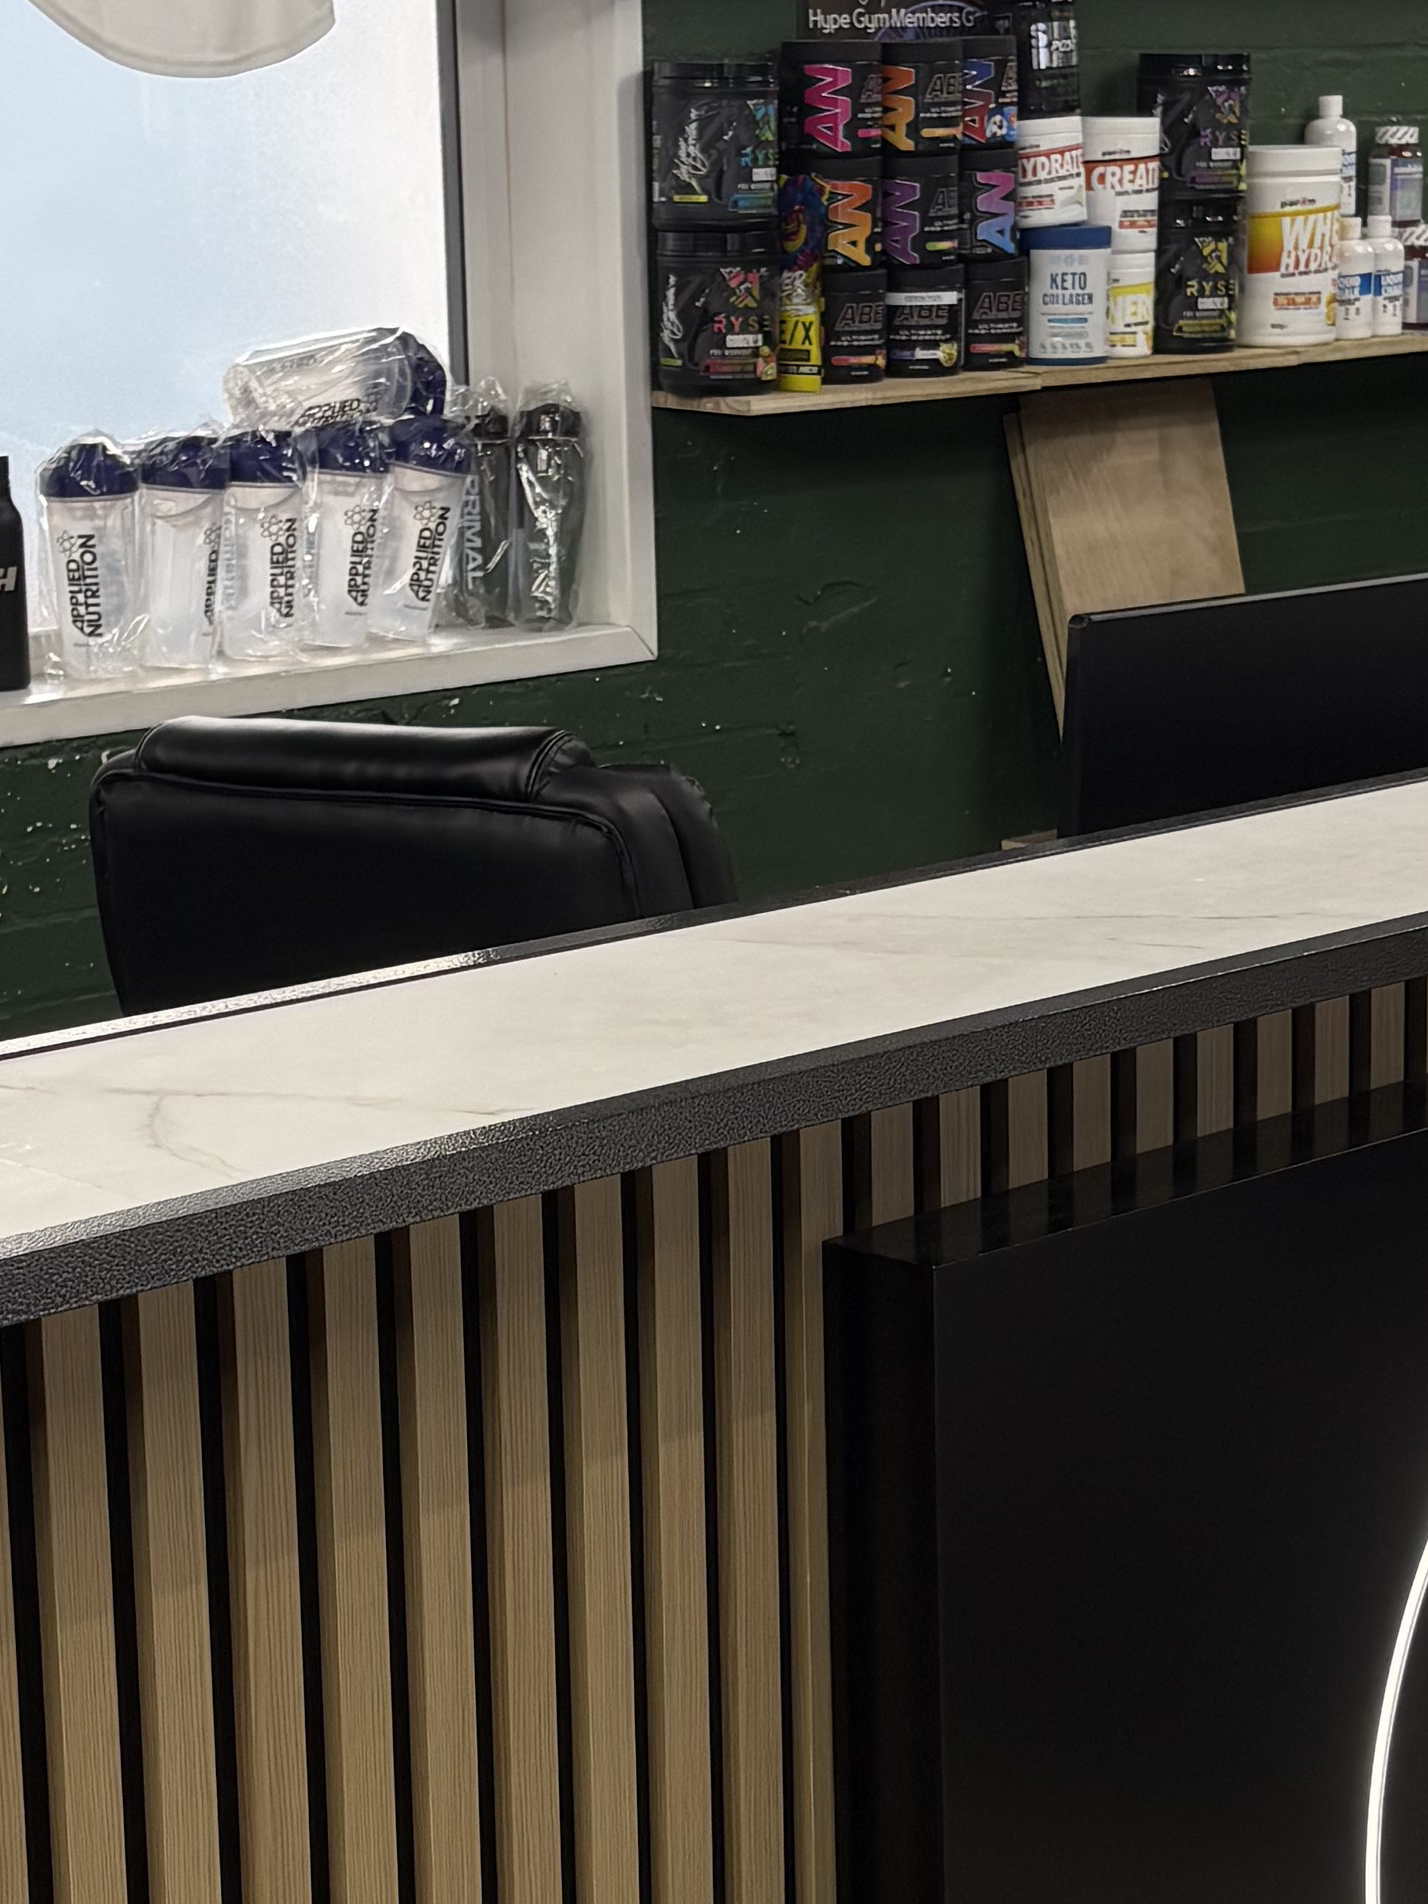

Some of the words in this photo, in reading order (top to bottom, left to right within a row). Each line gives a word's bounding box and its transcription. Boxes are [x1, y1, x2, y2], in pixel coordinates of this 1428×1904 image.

[809, 8, 851, 33] Hype
[853, 8, 890, 33] Gym
[890, 8, 962, 28] Members
[741, 146, 780, 167] RYS
[1018, 148, 1083, 178] YDRATE
[1091, 162, 1158, 192] CREAT
[1281, 212, 1340, 251] WHE
[1042, 293, 1094, 306] COLLAGEN
[1050, 272, 1087, 291] KETO
[1186, 280, 1236, 297] RYSE
[714, 315, 771, 333] RYSE
[292, 398, 361, 427] APPLIED
[461, 475, 484, 590] PRIMAL
[280, 517, 297, 618] NUTRITION
[347, 531, 367, 606] APPLIED
[408, 527, 433, 601] APPLIED
[419, 506, 451, 602] NUTRITION
[66, 558, 89, 636] APPLIED
[77, 533, 103, 637] NUTRITION
[204, 549, 219, 626] APPLIED
[270, 542, 286, 617] APPLIED
